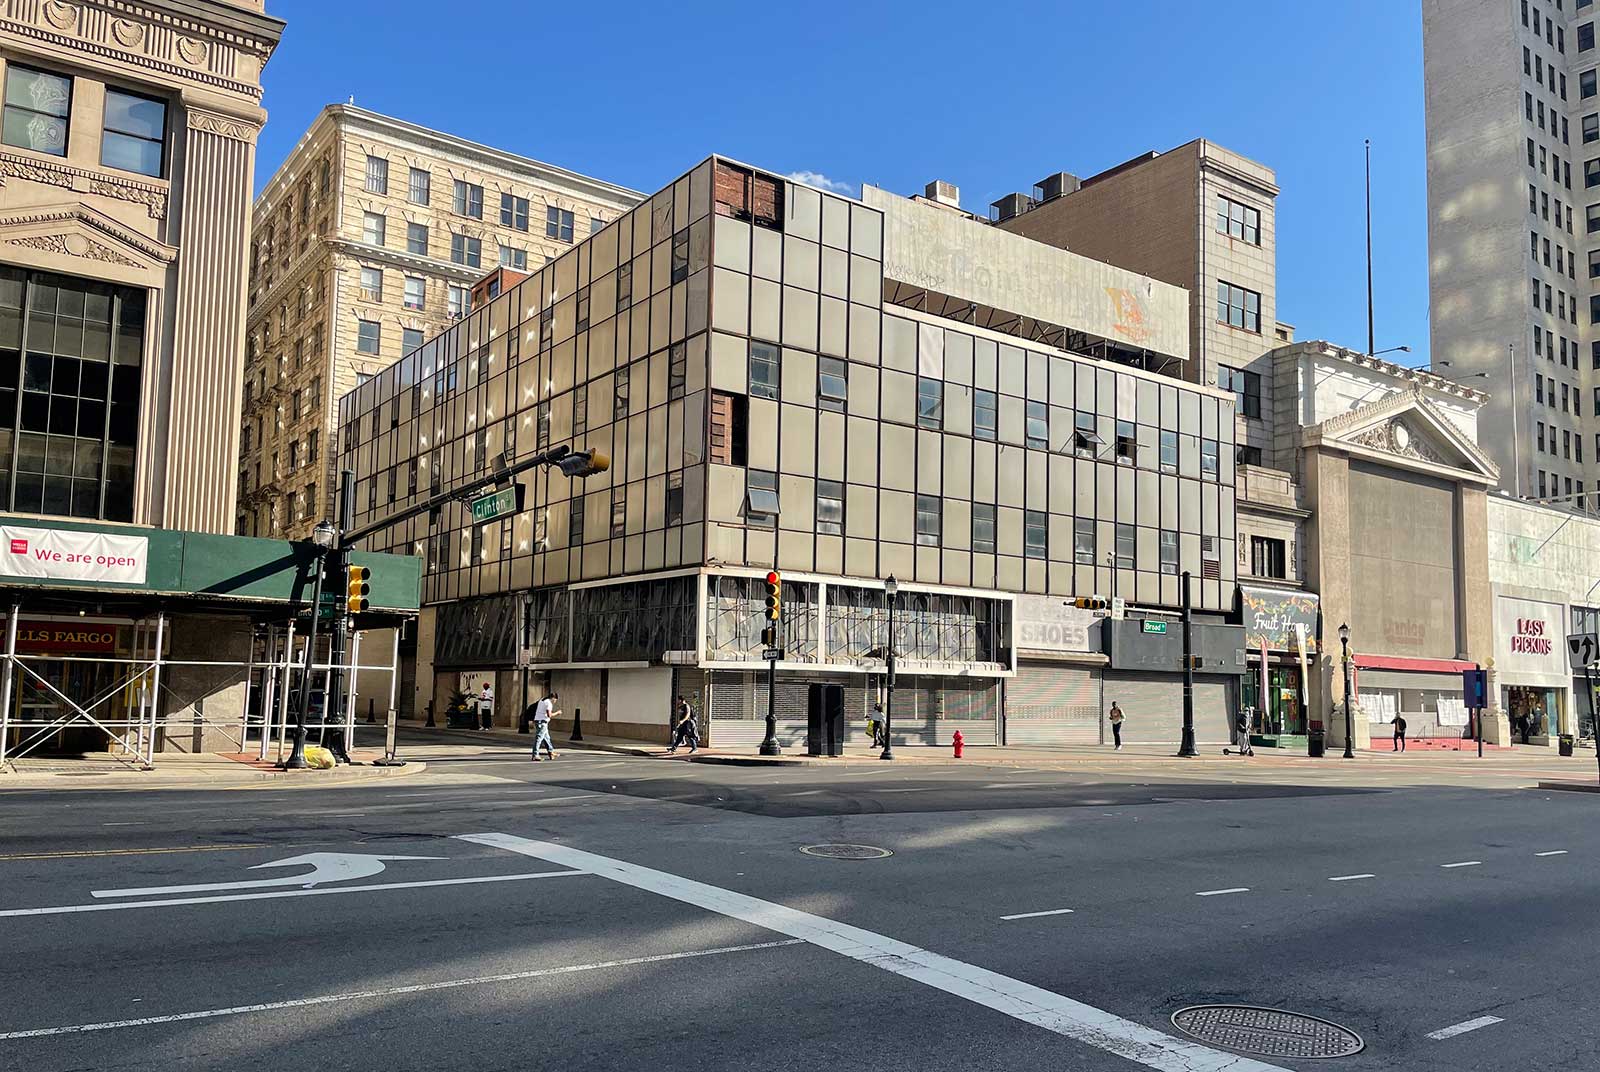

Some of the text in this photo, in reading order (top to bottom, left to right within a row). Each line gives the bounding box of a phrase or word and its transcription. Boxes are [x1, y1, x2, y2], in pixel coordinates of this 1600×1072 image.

[476, 499, 506, 518] Clinton
[35, 548, 136, 568] We are open
[1145, 622, 1162, 632] Broad
[1253, 612, 1311, 633] Fruit Hoe
[1517, 618, 1545, 637] EASY
[54, 631, 114, 644] FARGO
[1021, 623, 1085, 645] SHOES
[1511, 636, 1553, 655] PICKINS
